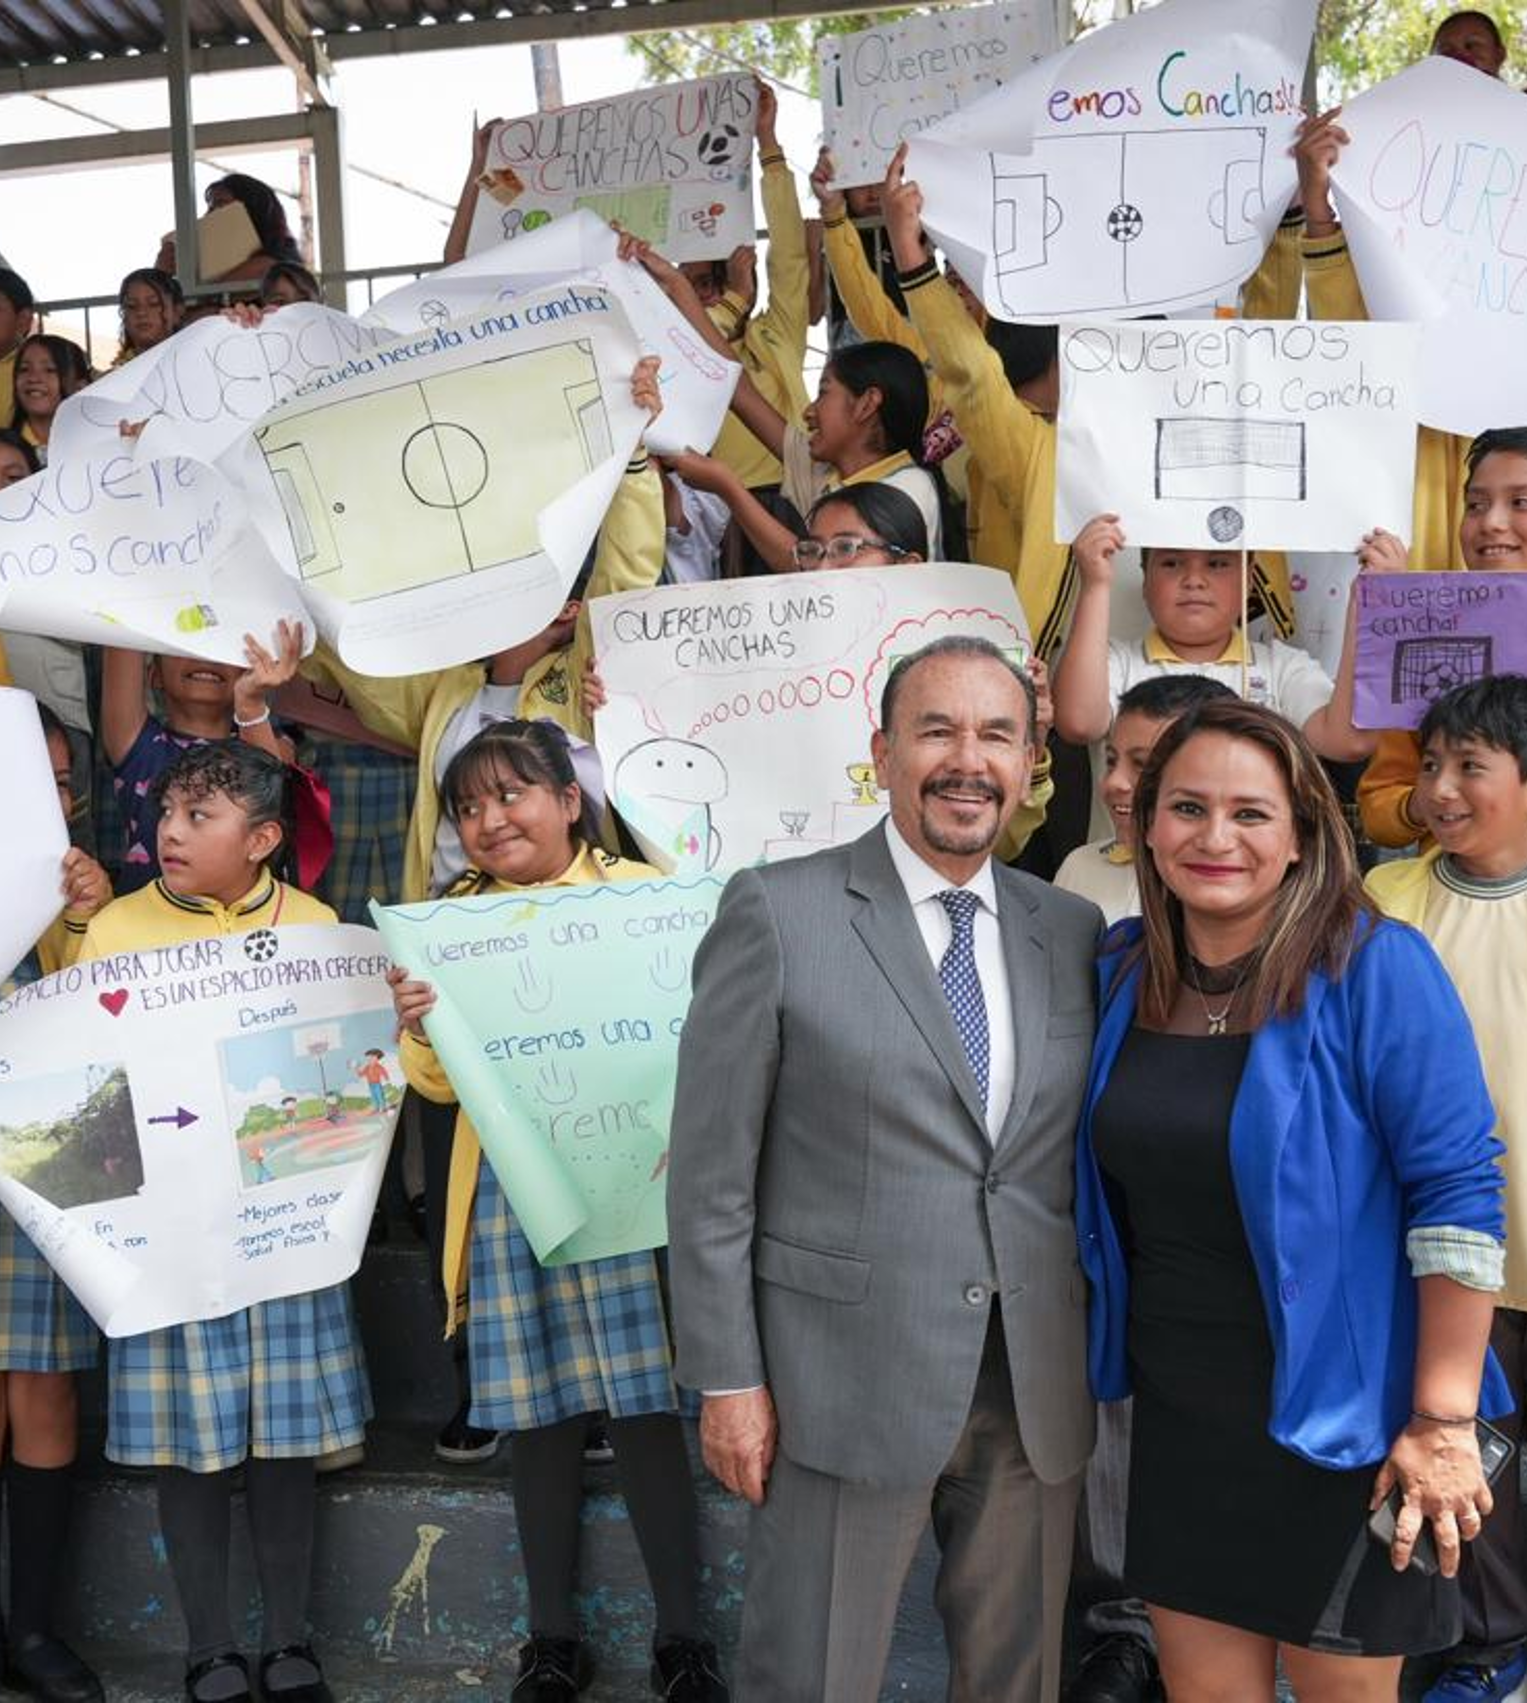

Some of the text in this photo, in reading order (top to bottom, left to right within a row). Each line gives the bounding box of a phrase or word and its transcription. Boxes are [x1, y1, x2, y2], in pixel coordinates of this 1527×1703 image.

[497, 78, 752, 164] QUEREMOS UNAS
[537, 140, 690, 194] CANCHAS
[470, 314, 519, 340] una
[1173, 379, 1262, 409] una
[613, 595, 835, 643] QUEREMOS UNAS
[675, 631, 795, 668] CANCHAS
[90, 953, 149, 986] PARA
[151, 940, 224, 983] JUGAR
[141, 987, 167, 1011] ES
[170, 981, 196, 1005] UN
[200, 965, 273, 999] ESPACIO
[275, 958, 323, 986] PARA
